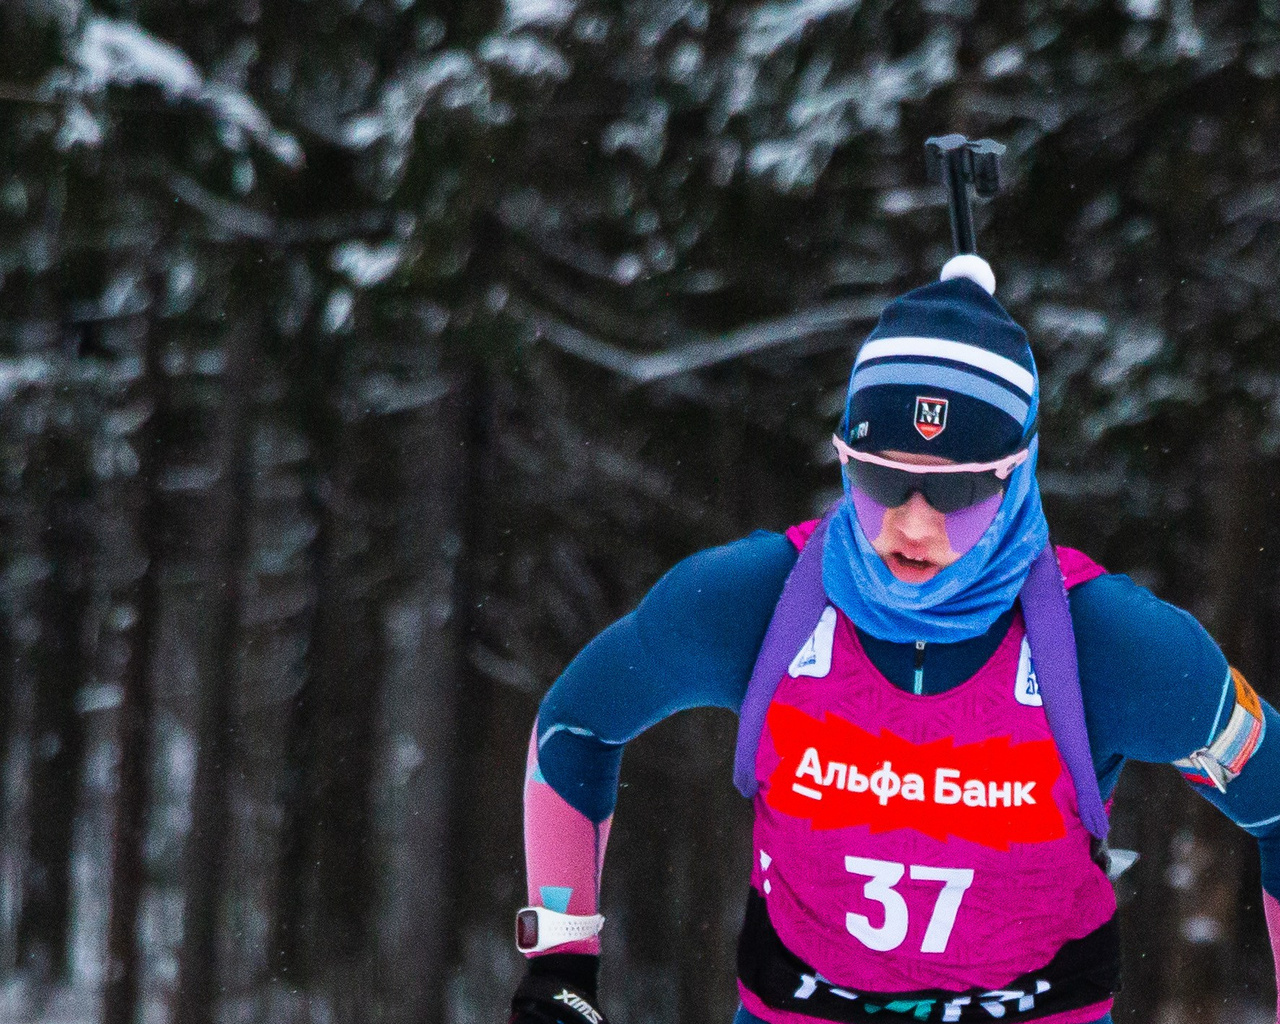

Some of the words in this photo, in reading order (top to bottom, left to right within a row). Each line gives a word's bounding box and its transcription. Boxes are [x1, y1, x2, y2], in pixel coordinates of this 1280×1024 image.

[792, 746, 925, 806] Альфа
[934, 767, 1037, 808] Банк
[844, 855, 975, 953] 37
